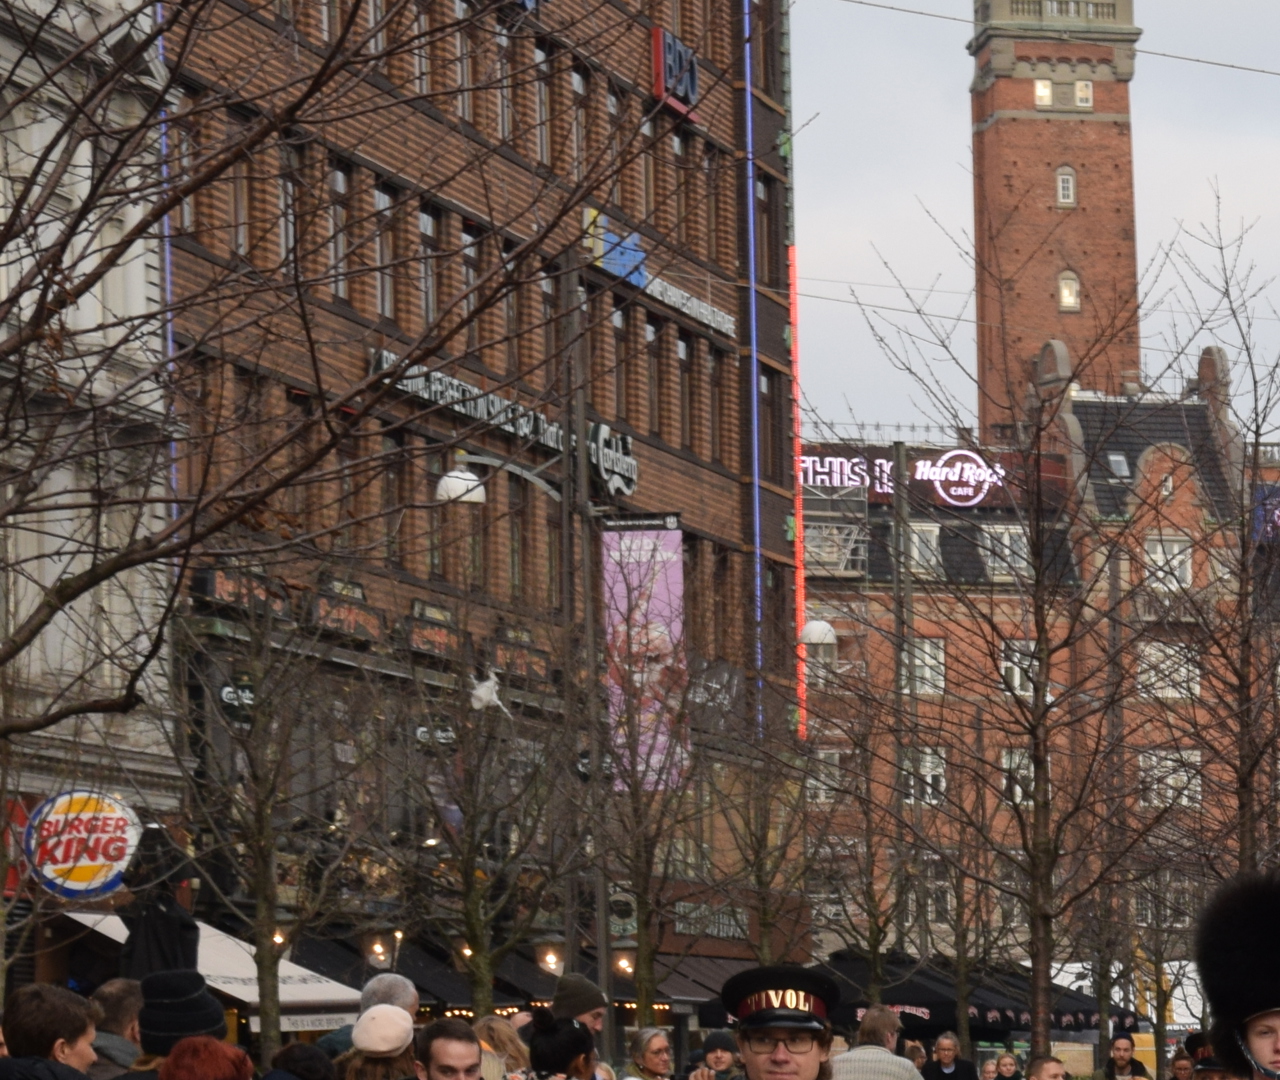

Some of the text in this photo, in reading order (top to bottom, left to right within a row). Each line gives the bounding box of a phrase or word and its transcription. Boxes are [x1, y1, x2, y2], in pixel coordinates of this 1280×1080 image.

[663, 31, 698, 105] BDO
[914, 459, 957, 482] Hard
[39, 816, 129, 842] BURGER
[36, 836, 129, 868] KING
